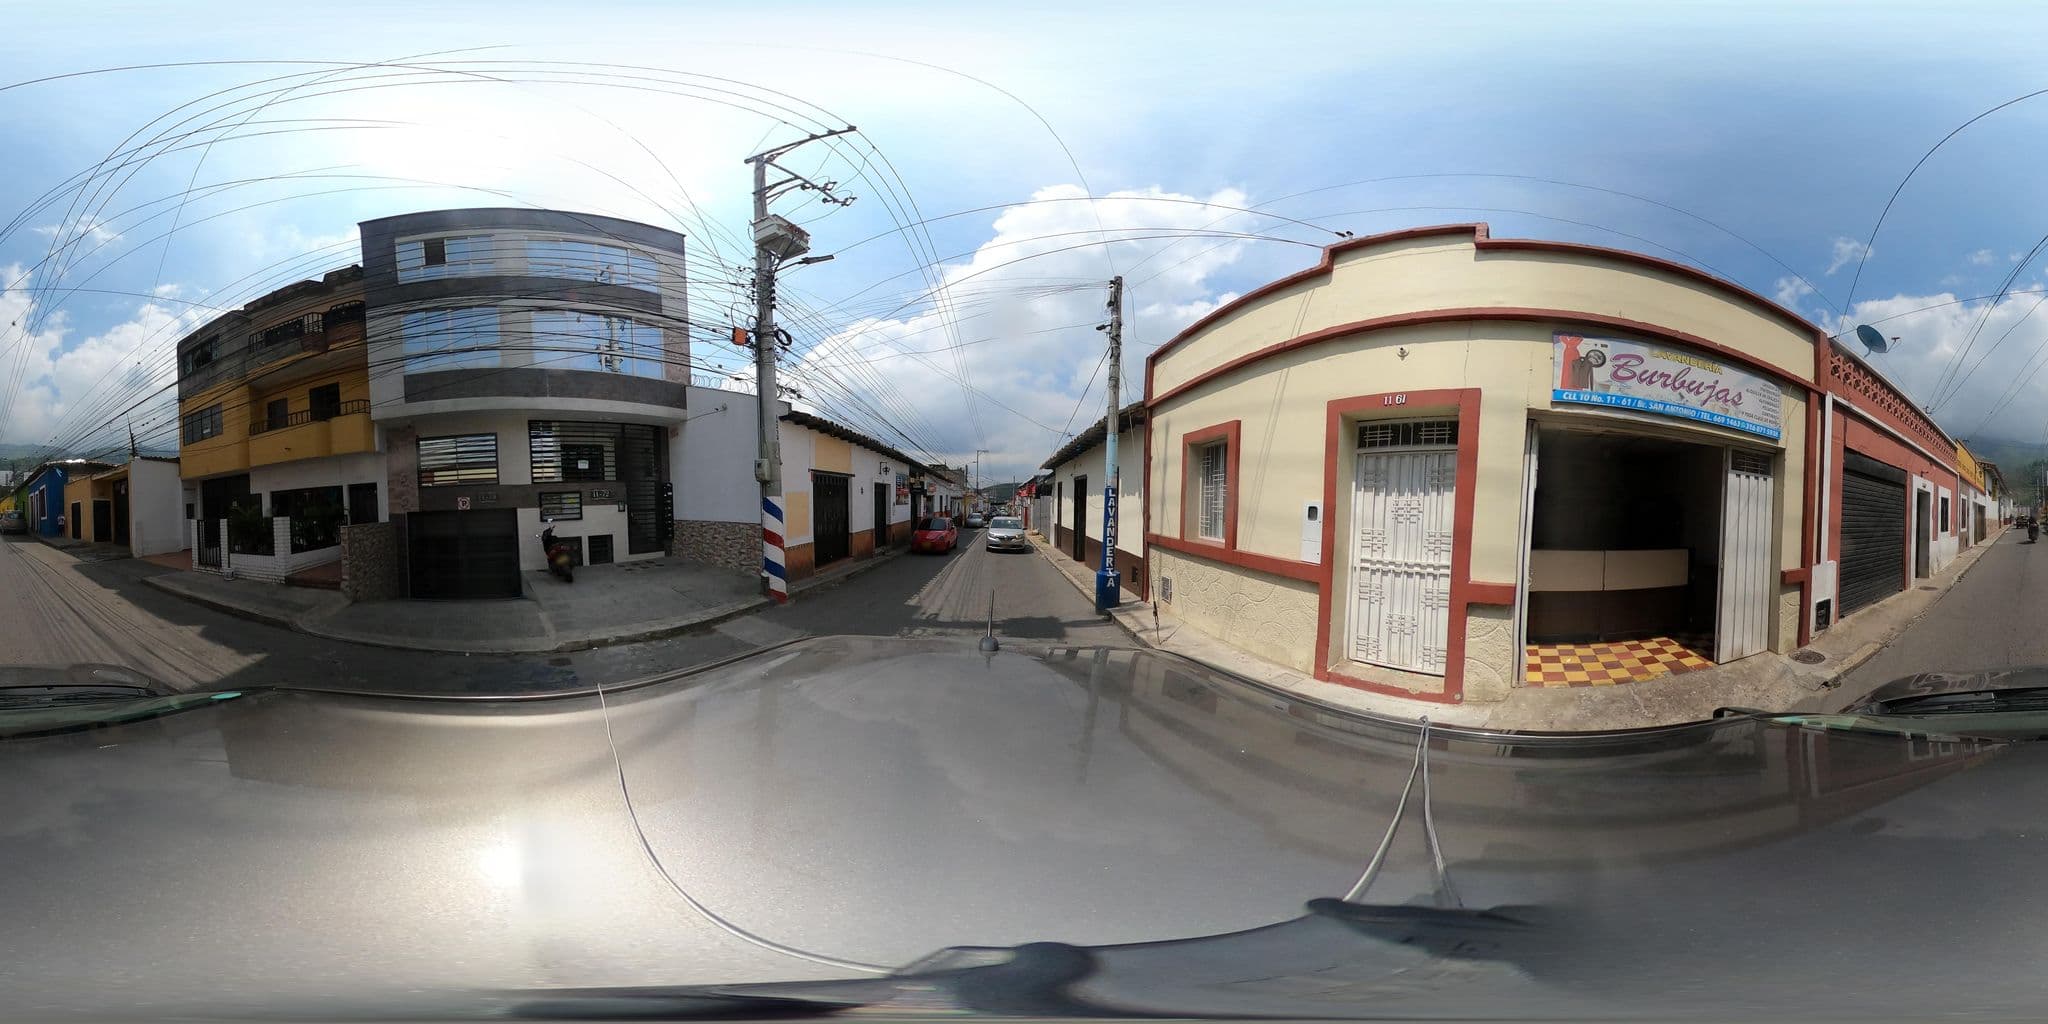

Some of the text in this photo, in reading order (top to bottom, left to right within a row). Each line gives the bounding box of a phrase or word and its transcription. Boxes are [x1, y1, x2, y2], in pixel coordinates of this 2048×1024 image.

[1395, 394, 1406, 405] 61
[1610, 353, 1743, 407] Burbujas
[1563, 392, 1577, 400] CLL
[1580, 392, 1590, 401] 10
[1591, 393, 1604, 403] No.
[1649, 401, 1665, 412] SAN
[1665, 404, 1697, 417] ANTONIO
[1106, 488, 1116, 588] LAVANDERIA
